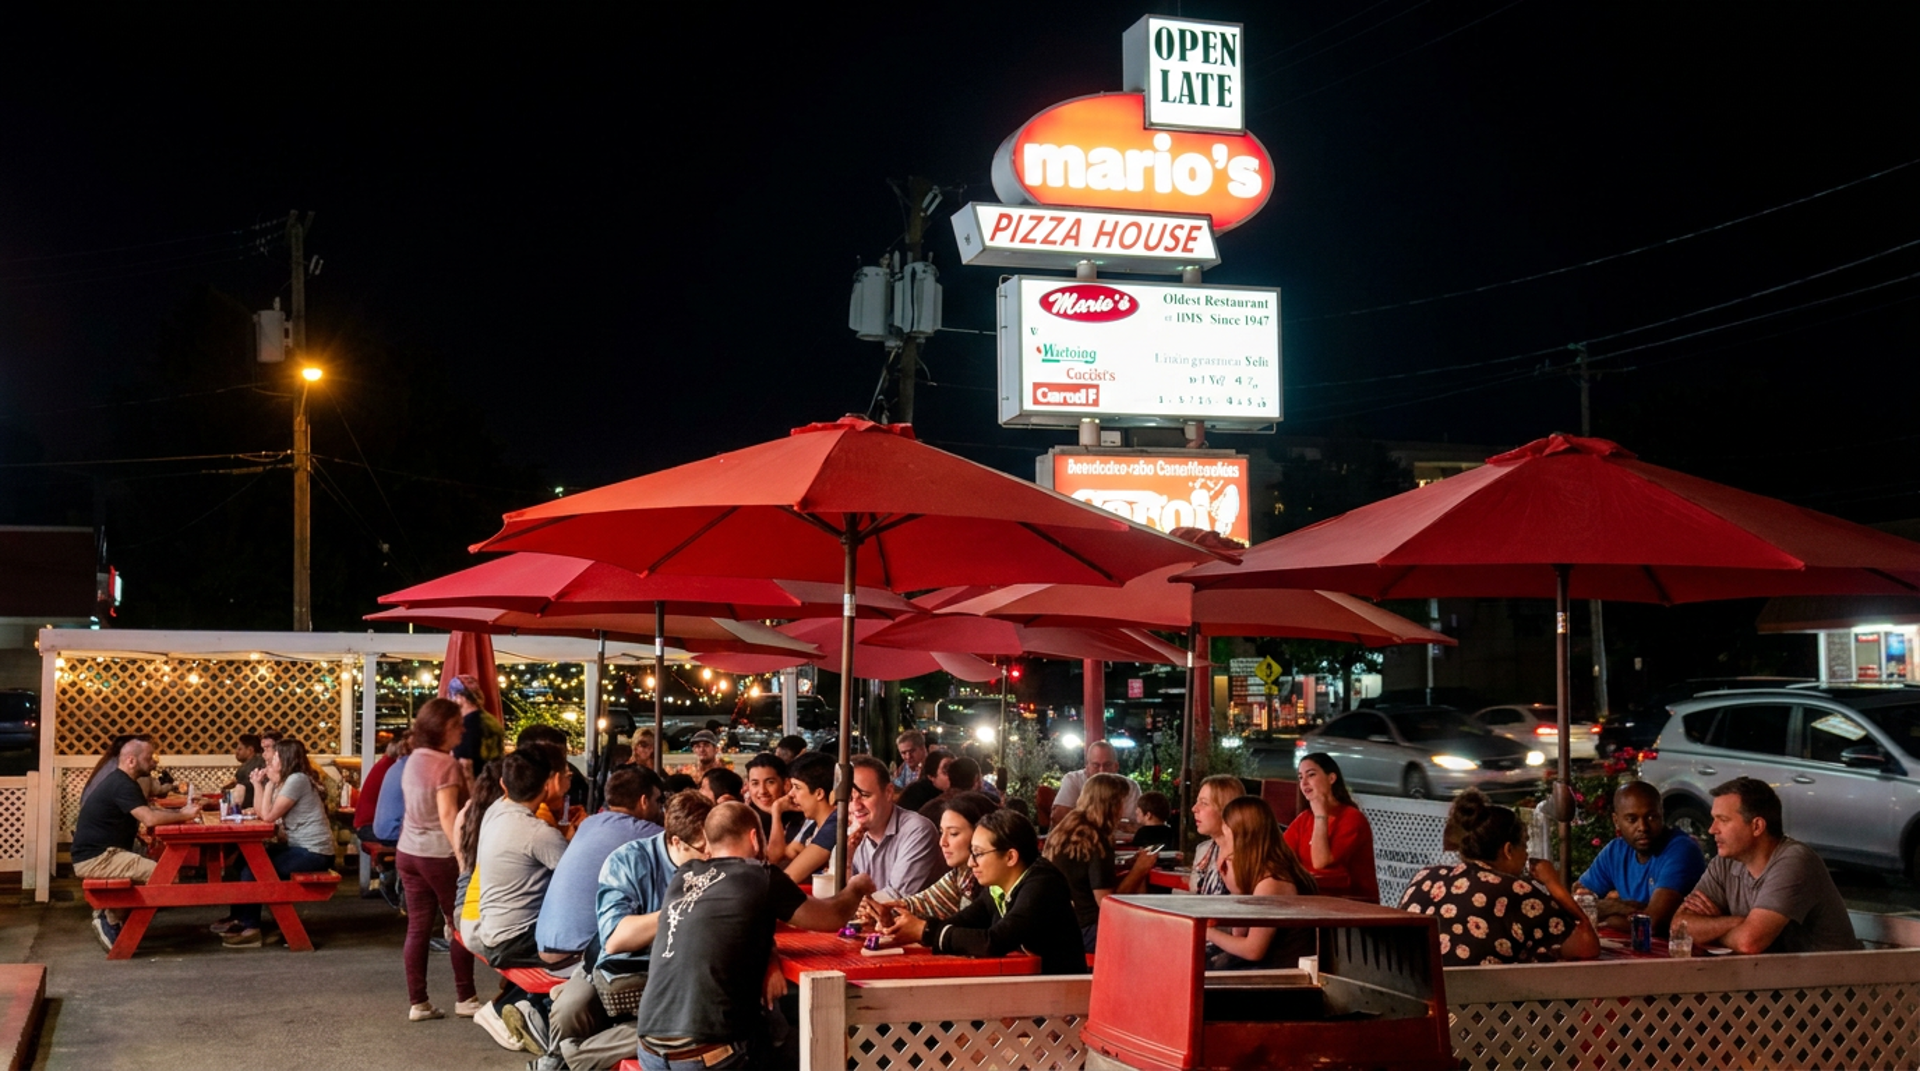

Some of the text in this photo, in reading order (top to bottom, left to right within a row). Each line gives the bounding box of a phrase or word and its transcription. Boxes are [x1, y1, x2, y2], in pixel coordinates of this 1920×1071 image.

[1154, 26, 1238, 68] OPEN
[1159, 69, 1233, 108] LATE
[1023, 133, 1263, 199] mario's
[989, 212, 1203, 253] PIZZA HOUSE
[1163, 292, 1269, 309] Oldest Restaurant
[1209, 314, 1241, 325] Since
[1244, 315, 1270, 326] 1947
